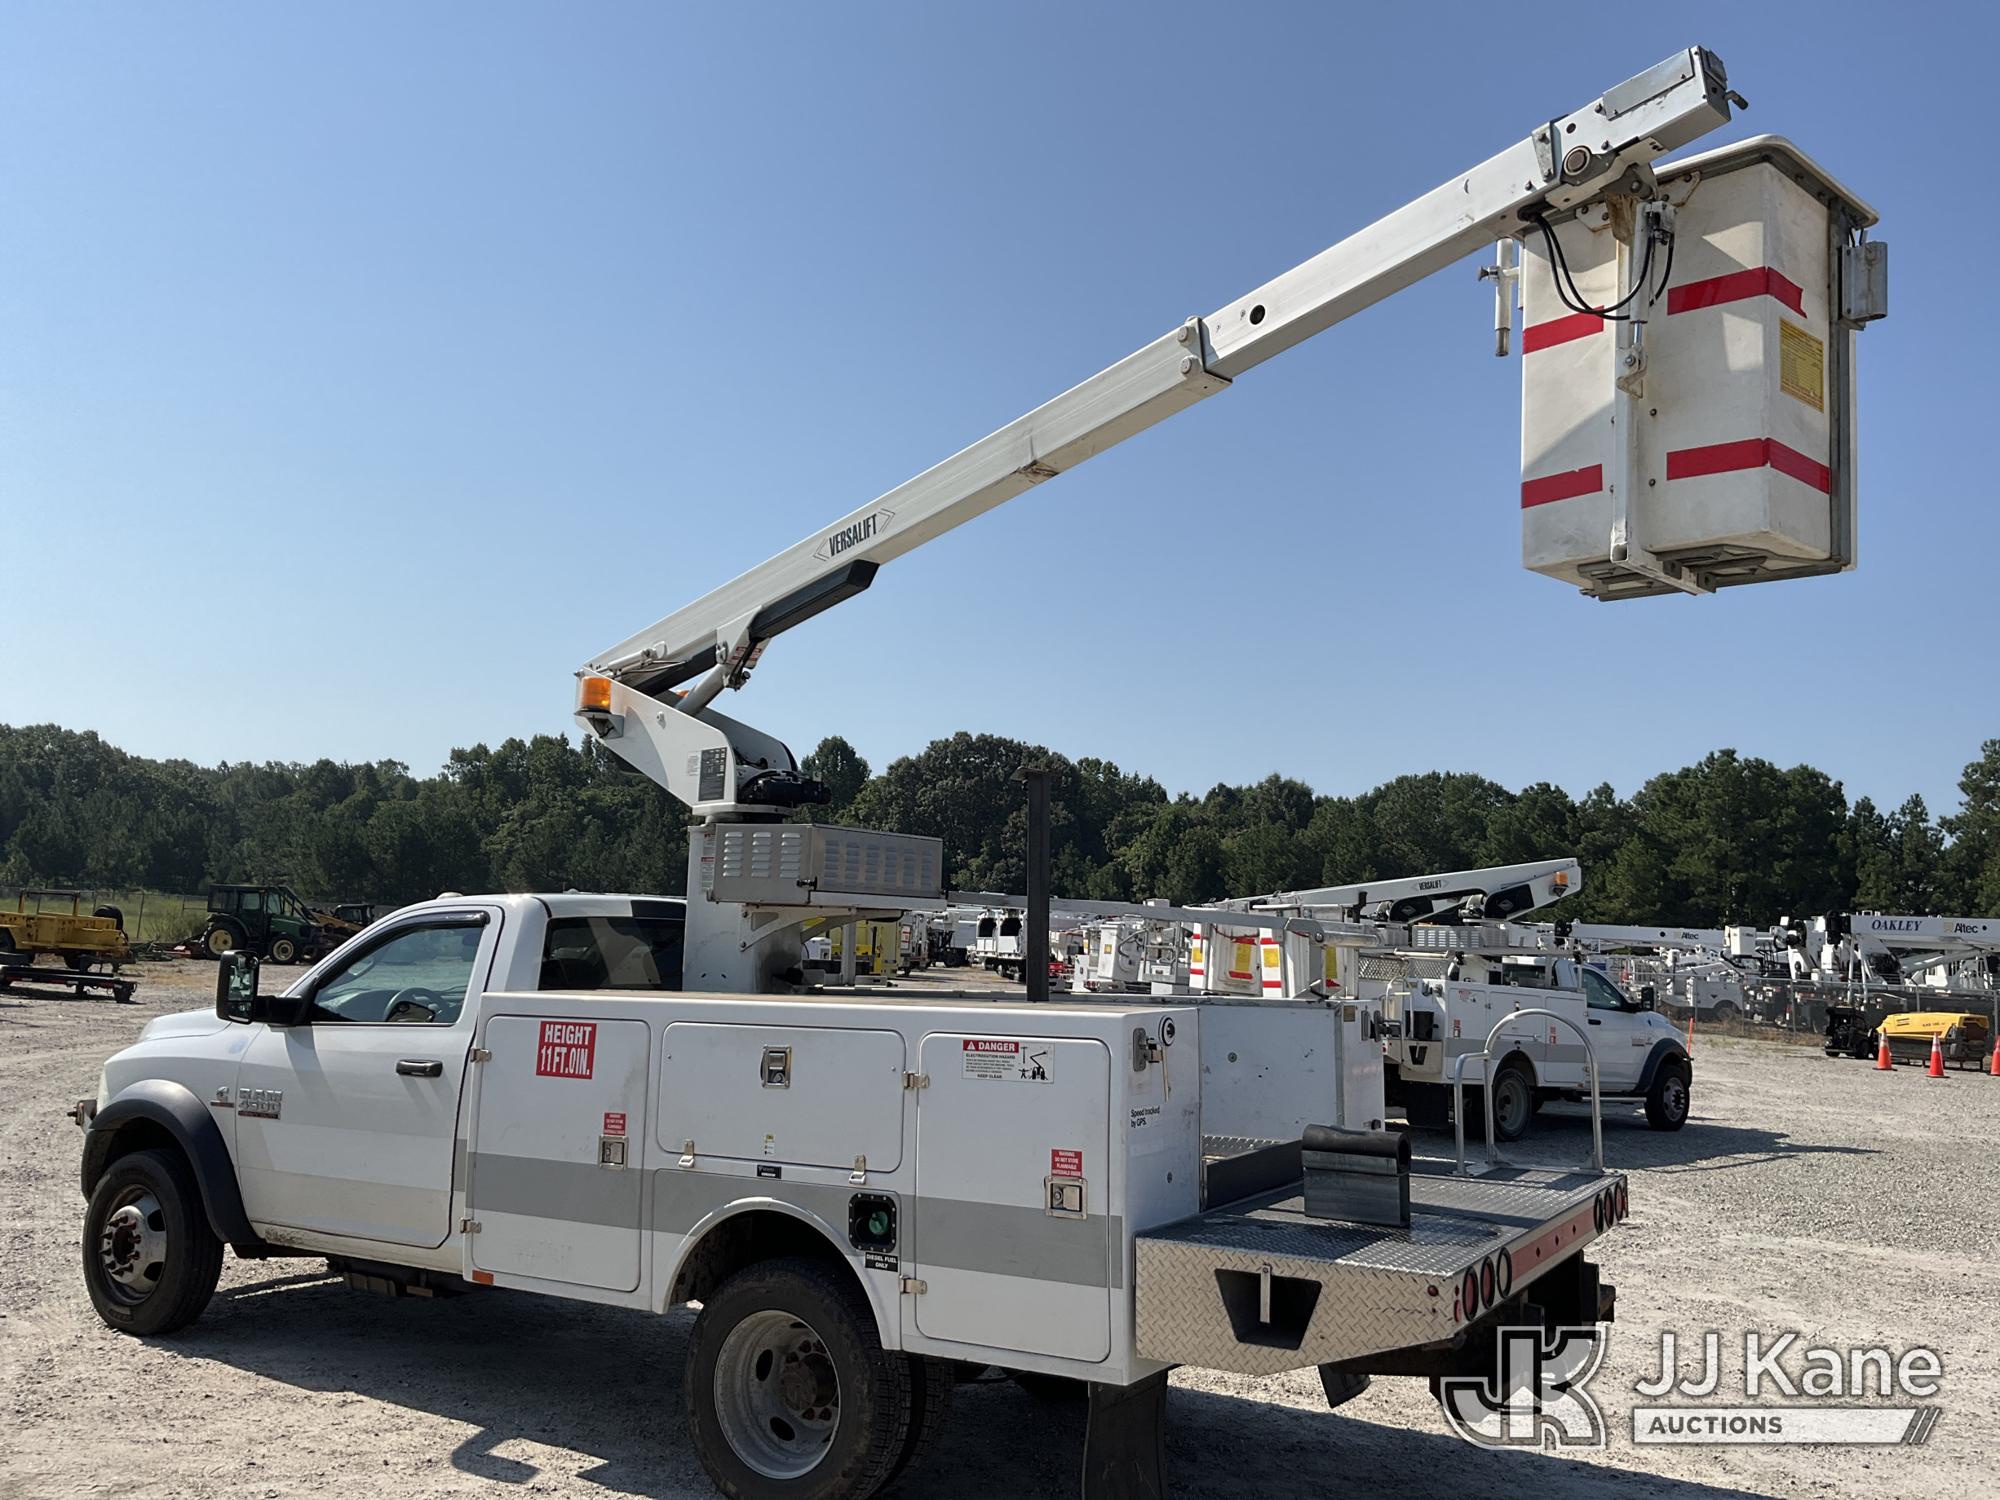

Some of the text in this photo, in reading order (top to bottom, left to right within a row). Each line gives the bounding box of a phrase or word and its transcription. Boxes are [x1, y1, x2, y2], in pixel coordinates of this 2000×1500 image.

[828, 513, 877, 557] VERSALIFT
[1871, 919, 1922, 932] OAKLEY
[1954, 922, 1979, 934] Altec
[1681, 931, 1699, 940] Altec
[544, 1023, 593, 1046] HEIGHT
[978, 1041, 1016, 1053] DANGER
[1130, 1108, 1144, 1119] Speed
[875, 1261, 888, 1269] ONLY
